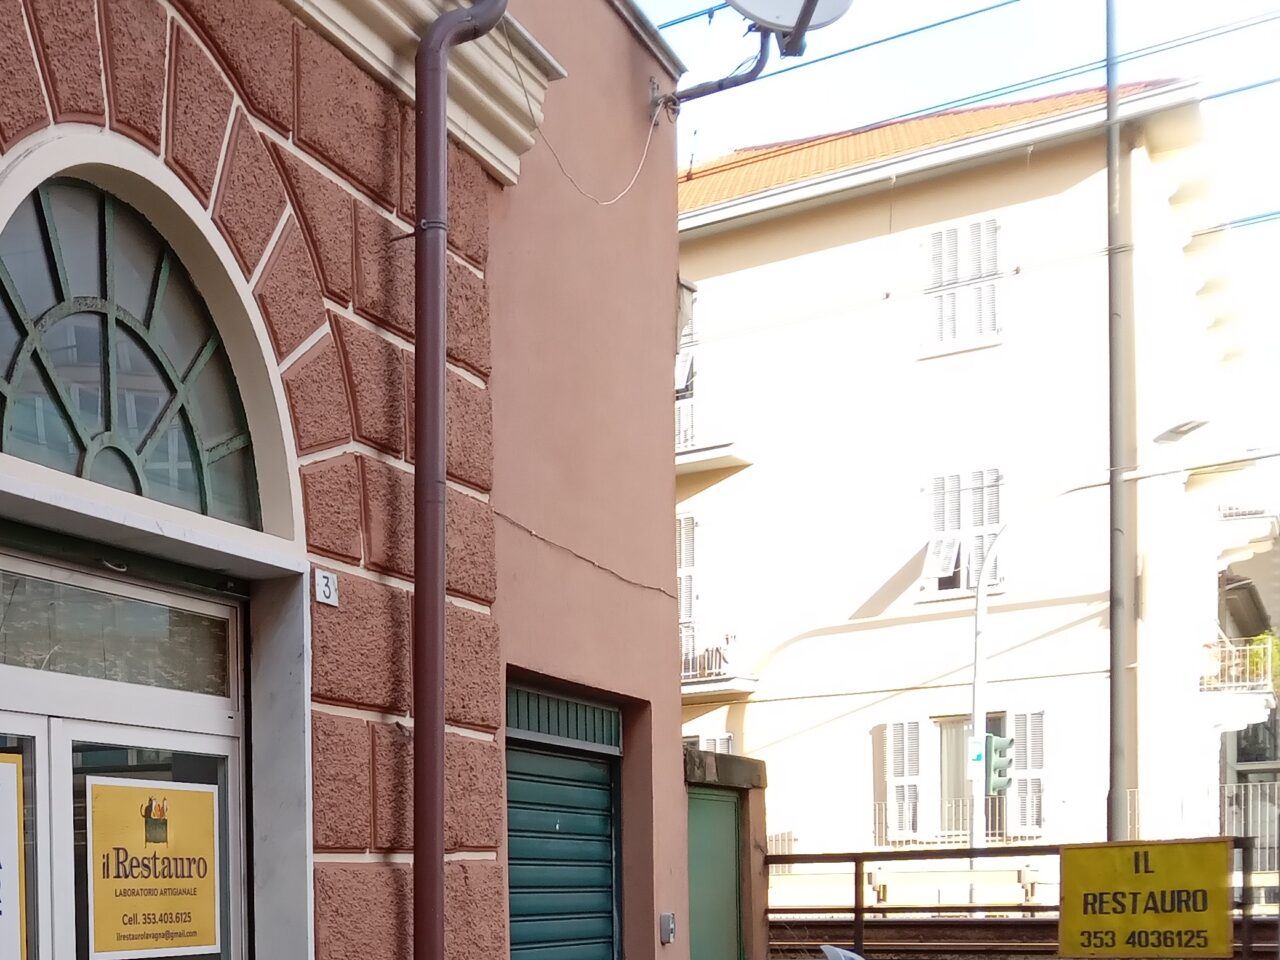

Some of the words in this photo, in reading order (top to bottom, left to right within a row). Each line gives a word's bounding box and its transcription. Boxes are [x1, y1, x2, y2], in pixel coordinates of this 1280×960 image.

[322, 575, 331, 599] 3
[102, 853, 110, 879] il
[112, 847, 208, 879] Restauro
[1134, 851, 1155, 874] IL
[114, 887, 159, 898] LABORATORIO
[160, 887, 198, 897] ARTIGIANALE
[1083, 889, 1208, 915] RESTAURO
[122, 913, 140, 925] Cell.
[142, 911, 192, 925] 353.403.6125
[1080, 930, 1116, 949] 353
[1125, 930, 1208, 949] 4036125
